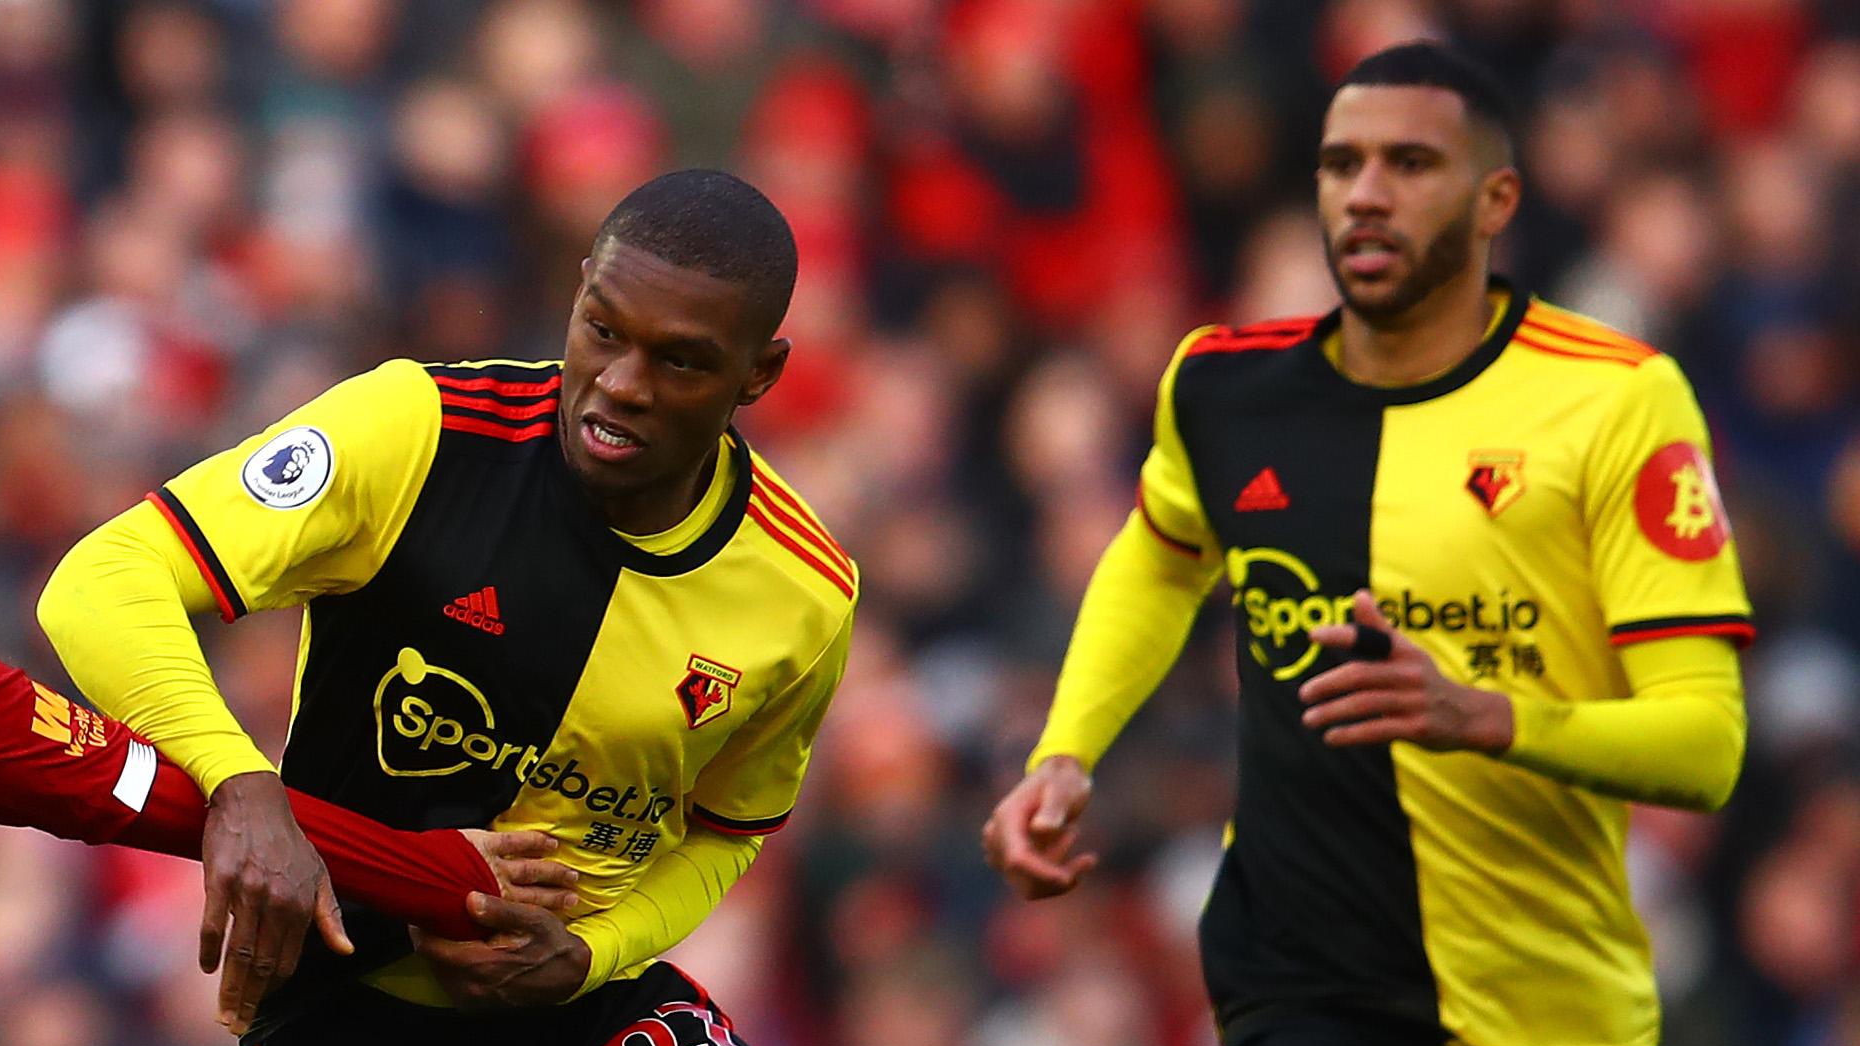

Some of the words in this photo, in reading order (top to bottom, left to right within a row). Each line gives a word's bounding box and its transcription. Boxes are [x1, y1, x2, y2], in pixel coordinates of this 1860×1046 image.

[443, 604, 506, 636] adidas
[1244, 586, 1539, 648] Sporsbet.io
[694, 660, 735, 681] WATFORD
[393, 695, 676, 825] Sportsbet.io
